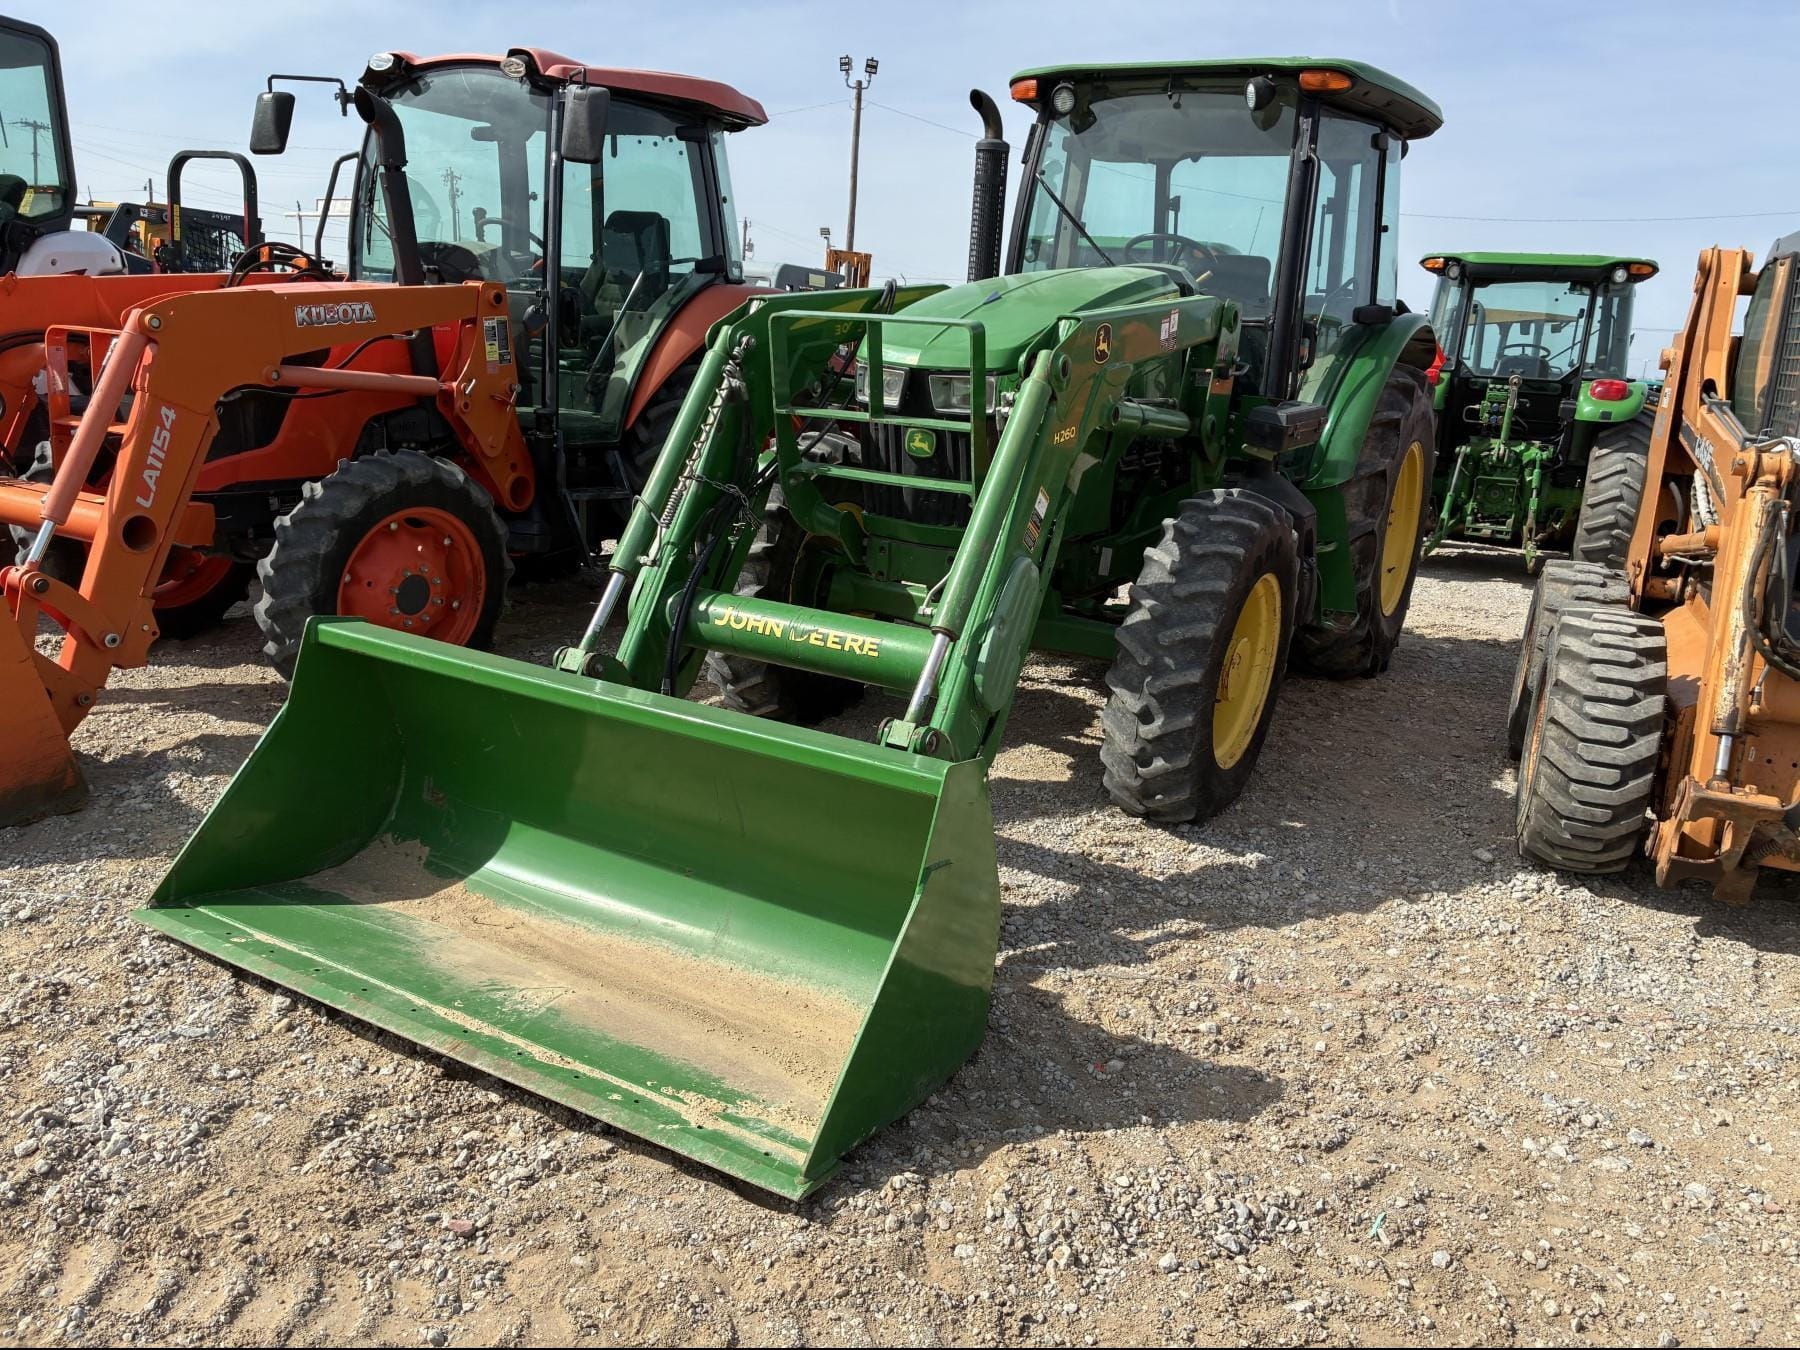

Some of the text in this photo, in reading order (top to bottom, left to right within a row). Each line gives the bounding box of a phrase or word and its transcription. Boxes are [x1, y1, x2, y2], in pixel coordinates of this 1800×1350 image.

[295, 302, 376, 327] KUBOTA
[1054, 426, 1076, 445] H260
[136, 406, 176, 508] LA1154
[714, 606, 785, 638] JOHN
